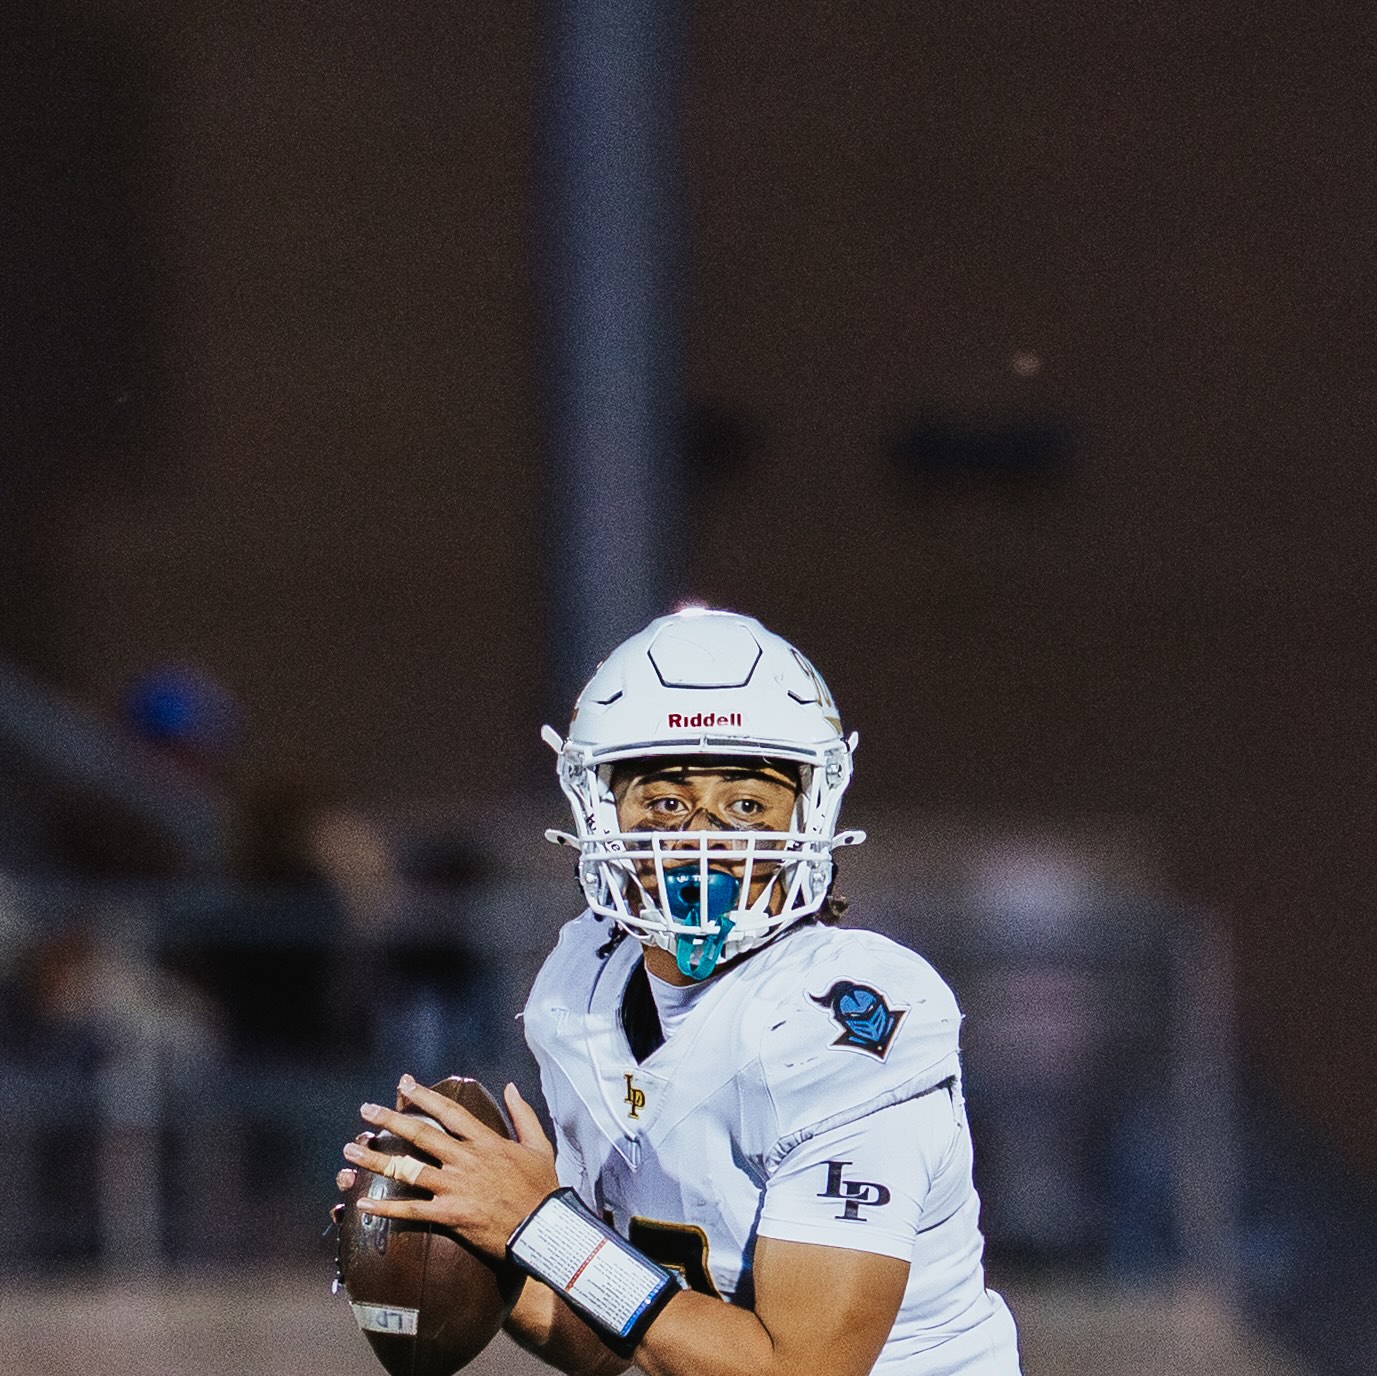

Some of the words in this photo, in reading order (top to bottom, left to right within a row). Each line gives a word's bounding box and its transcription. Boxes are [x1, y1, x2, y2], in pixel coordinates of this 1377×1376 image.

[668, 712, 742, 728] Riddell
[623, 1073, 646, 1120] LP
[816, 1160, 891, 1222] LP
